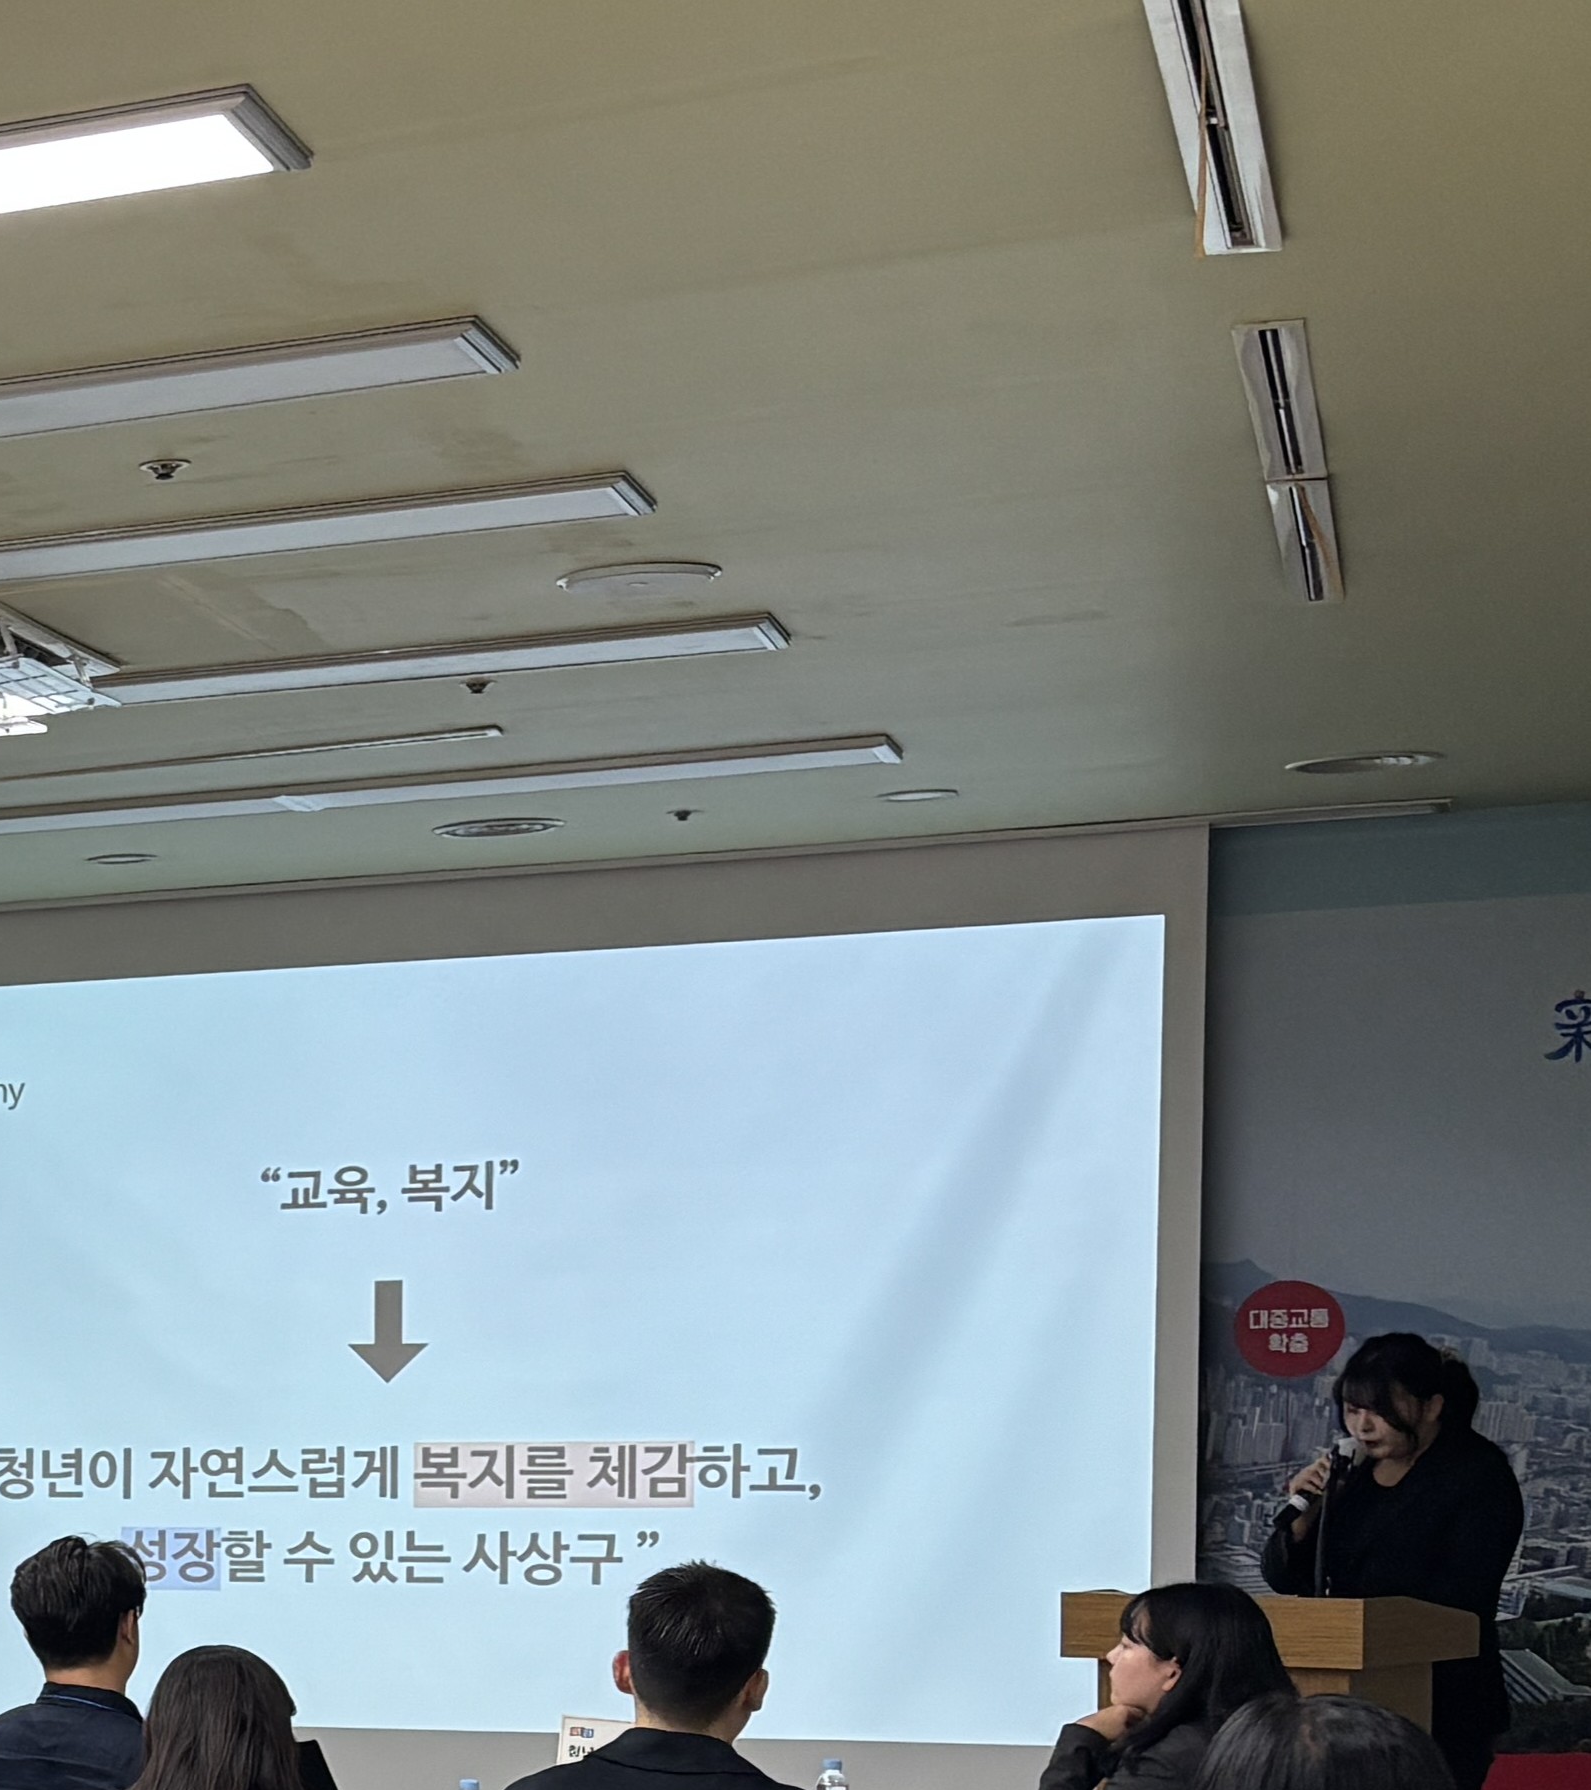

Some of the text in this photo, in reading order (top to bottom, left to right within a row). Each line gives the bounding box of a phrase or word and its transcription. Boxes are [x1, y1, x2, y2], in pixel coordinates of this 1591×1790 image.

[260, 1158, 519, 1215] “교육, 복지”
[1249, 1308, 1329, 1329] 대중교통
[1268, 1332, 1309, 1353] 확충
[148, 1445, 399, 1500] 자연스럽게
[414, 1444, 574, 1500] 복지를
[586, 1443, 822, 1501] 체감하고,
[130, 1529, 272, 1584] 성장할
[283, 1530, 335, 1584] 수
[349, 1530, 452, 1584] 있는
[462, 1530, 623, 1586] 사상구
